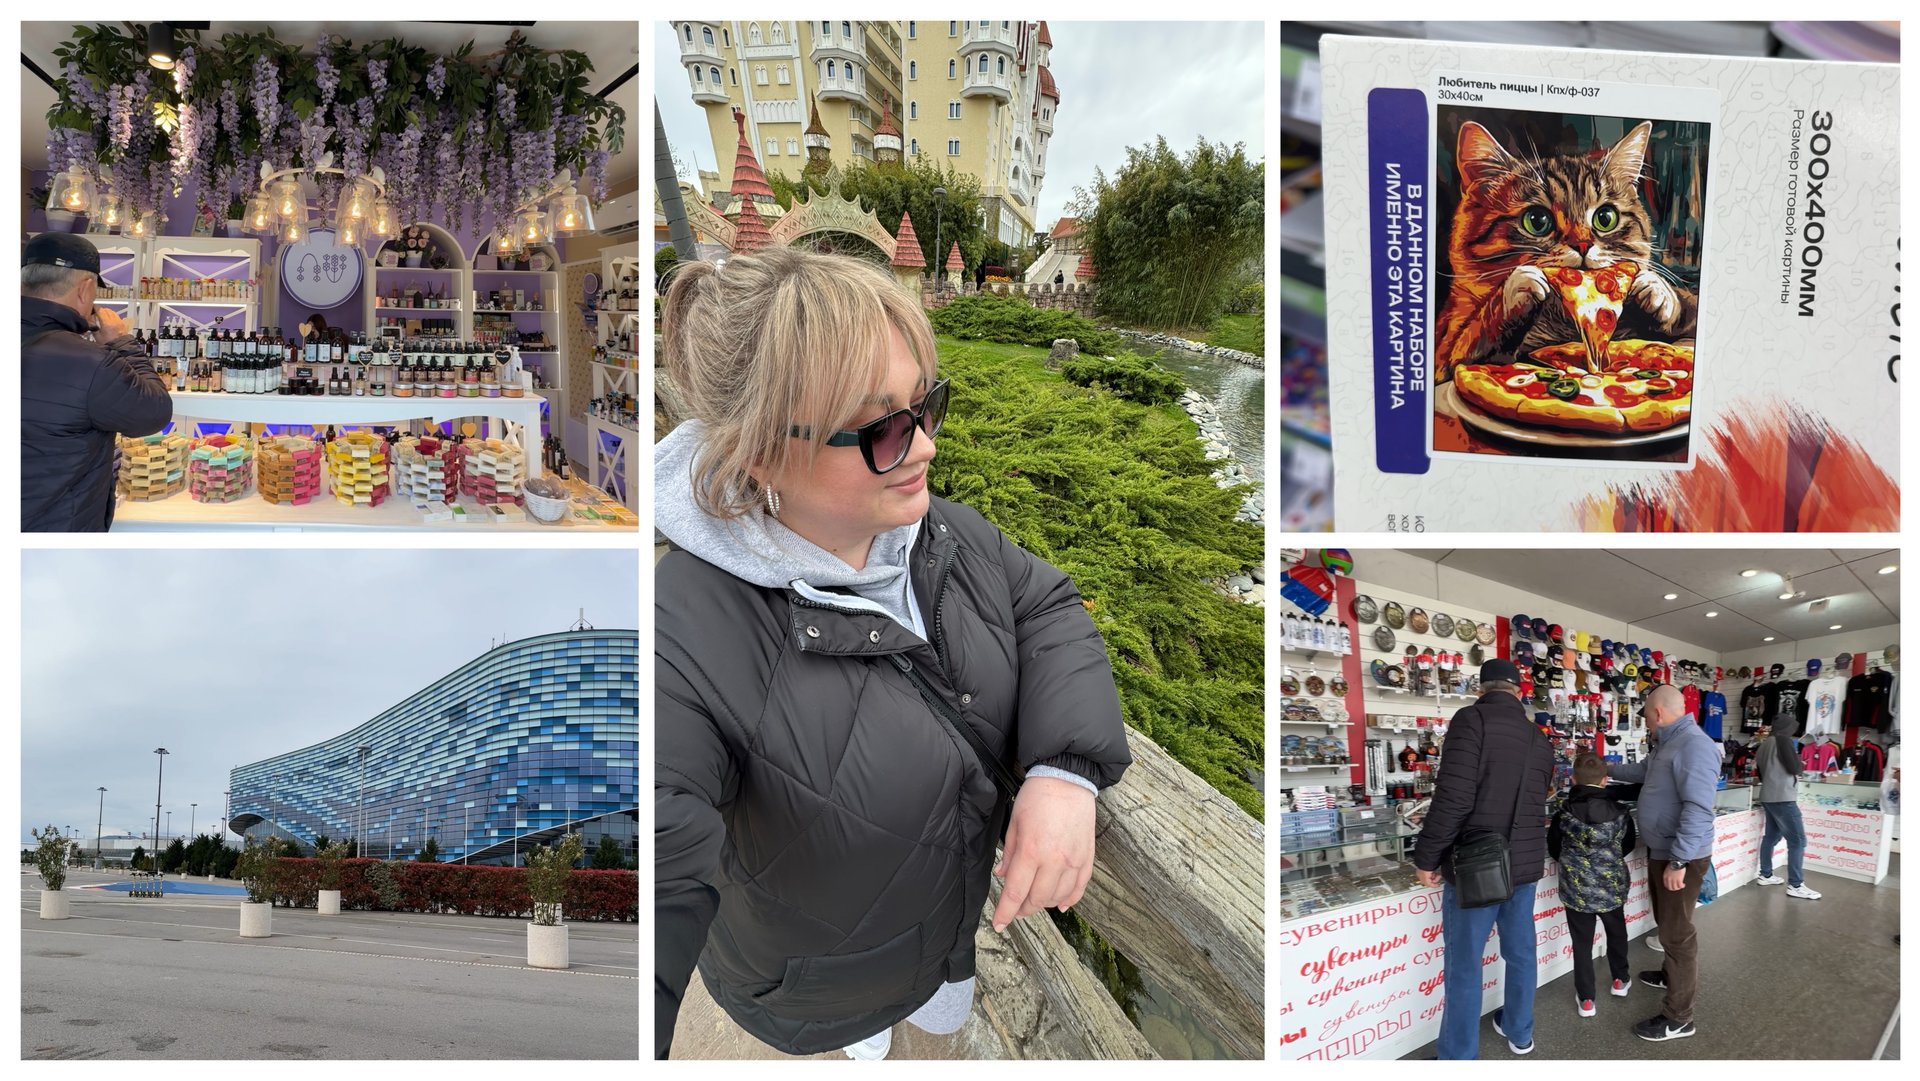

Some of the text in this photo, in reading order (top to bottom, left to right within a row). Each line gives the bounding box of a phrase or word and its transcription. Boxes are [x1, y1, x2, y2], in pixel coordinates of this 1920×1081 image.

[1437, 89, 1484, 102] 30х40см
[1438, 76, 1497, 90] Любитель
[1499, 81, 1538, 93] пиццы
[1546, 84, 1601, 98] Кпх/ф-037
[1780, 109, 1805, 304] Размер готовой картины
[1798, 110, 1833, 317] 300х400мм
[1386, 162, 1405, 410] ИМЕННО ЭТА КАРТИНА
[1405, 184, 1425, 392] В ДАННОМ НАБОРЕ
[1281, 902, 1404, 946] сувениры
[1300, 932, 1411, 985] сувениры
[1307, 963, 1407, 1007] сувениры
[1318, 987, 1413, 1042] сувениры
